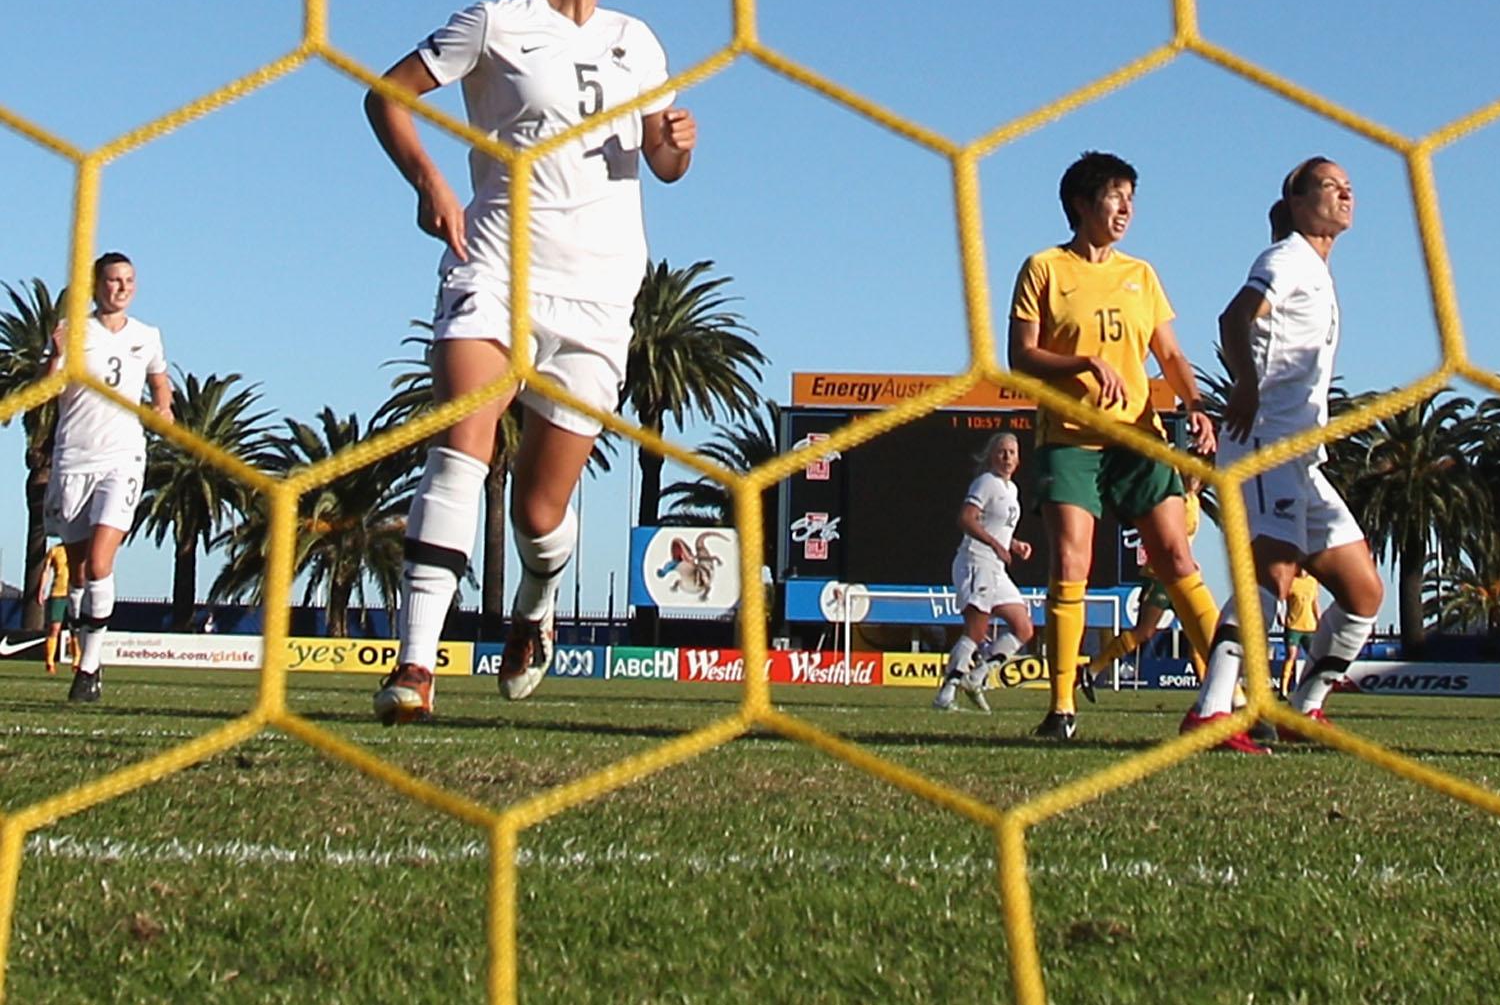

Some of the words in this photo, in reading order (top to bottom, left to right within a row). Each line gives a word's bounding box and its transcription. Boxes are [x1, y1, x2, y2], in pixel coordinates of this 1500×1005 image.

[573, 61, 604, 120] 5
[1095, 308, 1123, 342] 15
[104, 356, 122, 388] 3
[1010, 418, 1032, 430] NZL
[125, 478, 138, 507] 3
[358, 646, 450, 667] OPS
[476, 654, 503, 674] AB
[1358, 674, 1470, 692] QANTAS
